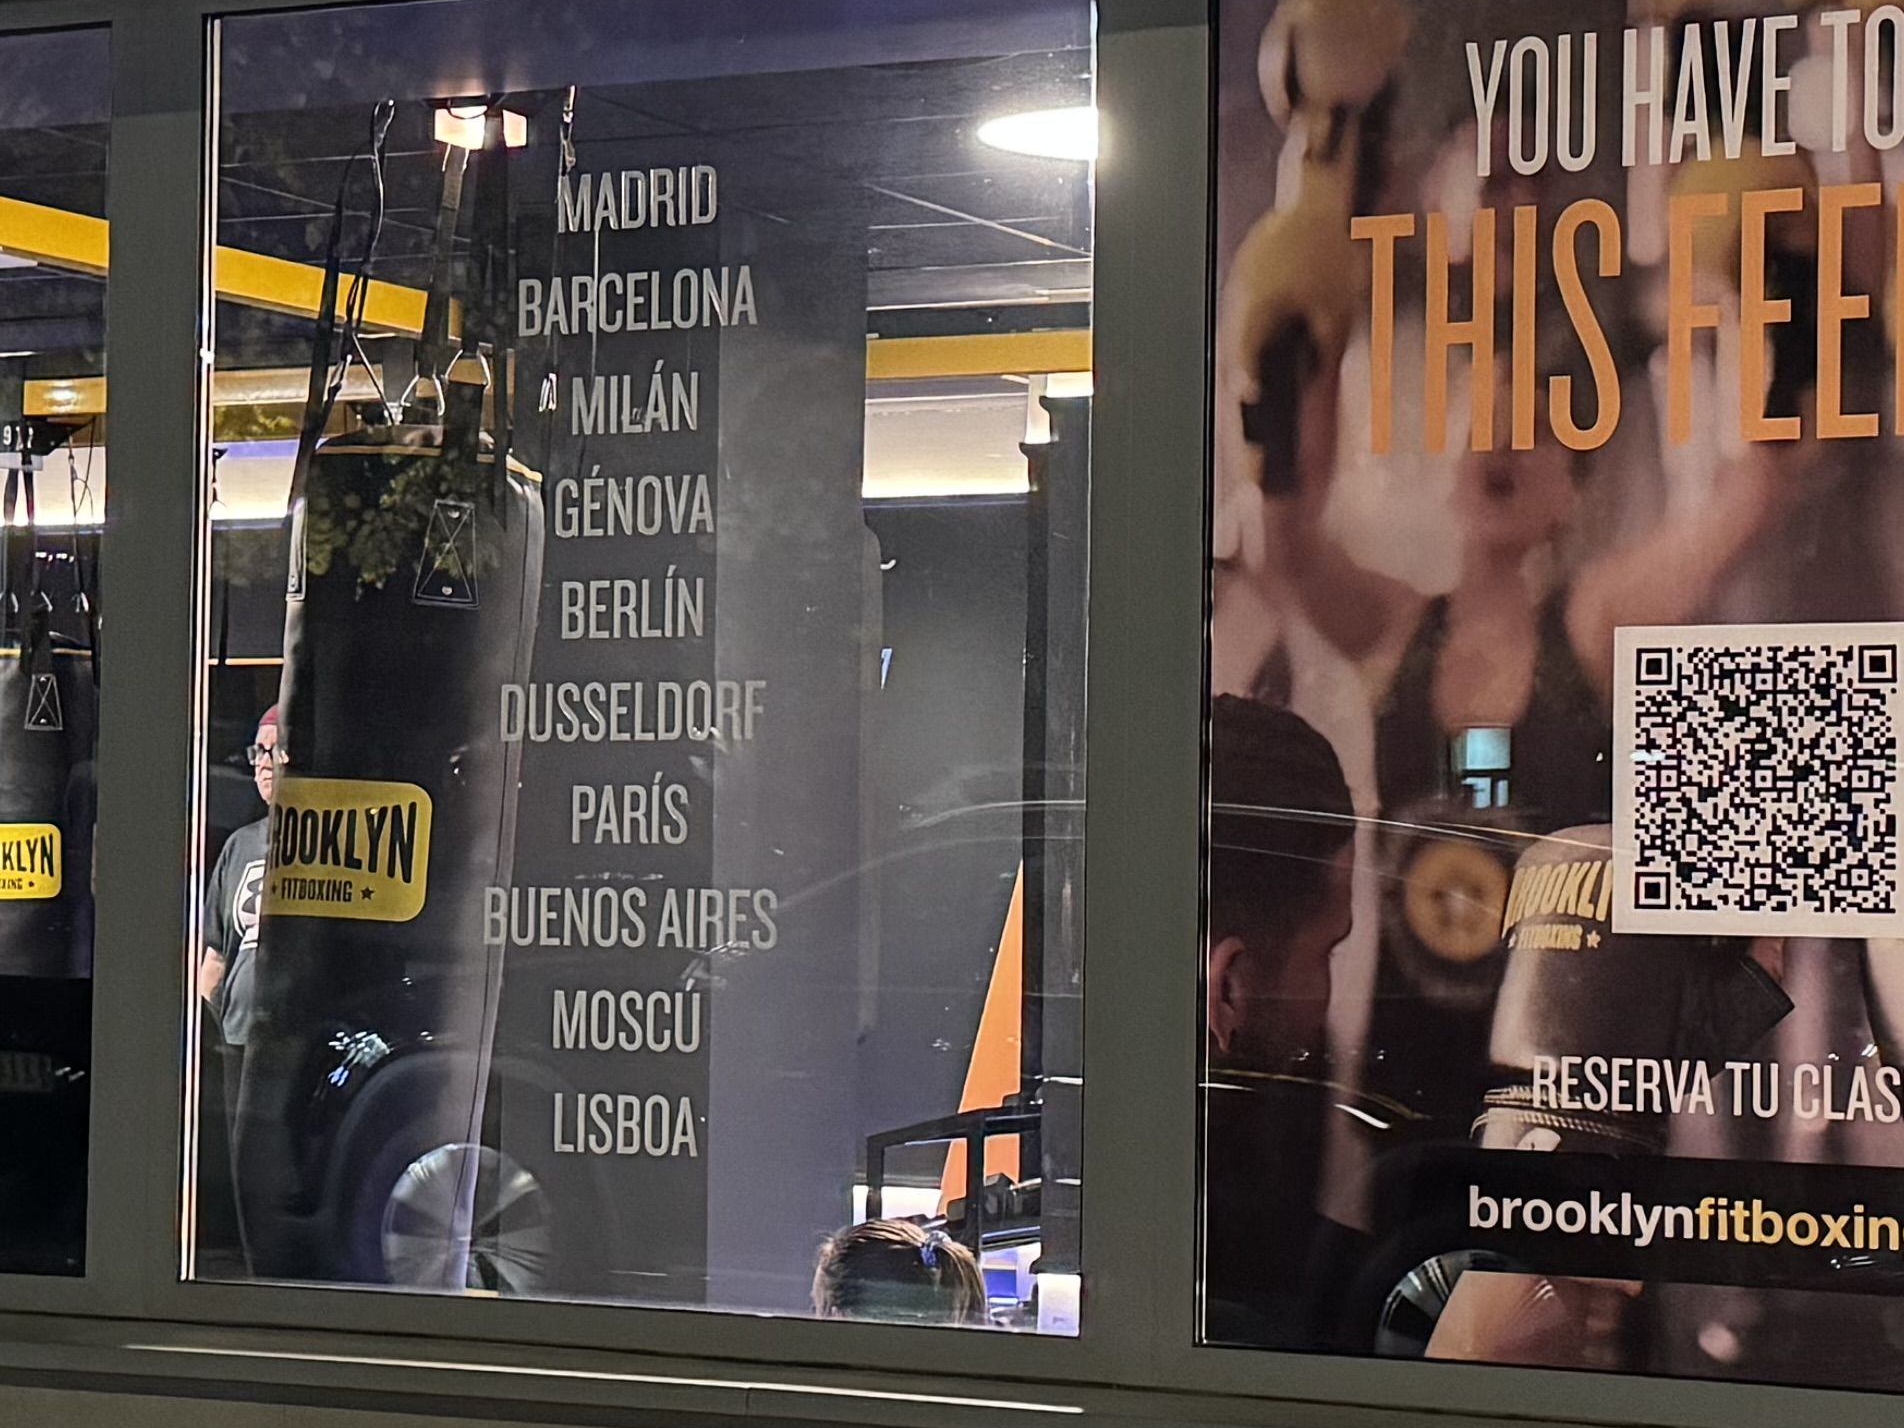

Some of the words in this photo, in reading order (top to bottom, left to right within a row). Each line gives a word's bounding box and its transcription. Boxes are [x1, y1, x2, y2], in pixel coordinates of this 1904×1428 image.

[1465, 32, 1598, 178] YOU
[1621, 14, 1799, 168] HAVE
[557, 165, 719, 234] MADRID
[517, 265, 759, 338] BARCELONA
[1349, 198, 1622, 455] THIS
[570, 359, 699, 436] MILÁN
[553, 465, 716, 538] GÉNOVA
[560, 564, 705, 641] BERLÍN
[499, 679, 767, 743] DUSSELDORF
[268, 801, 417, 884] ROOKLYN
[571, 771, 689, 845] PARÍS
[280, 877, 354, 903] FITBOXING
[482, 886, 647, 948] BUENOS
[657, 887, 780, 951] AIRES
[552, 978, 702, 1054] MOSCÚ
[1532, 1055, 1716, 1117] RESERVA
[1724, 1061, 1780, 1119] TU
[553, 1092, 699, 1158] LISBOA
